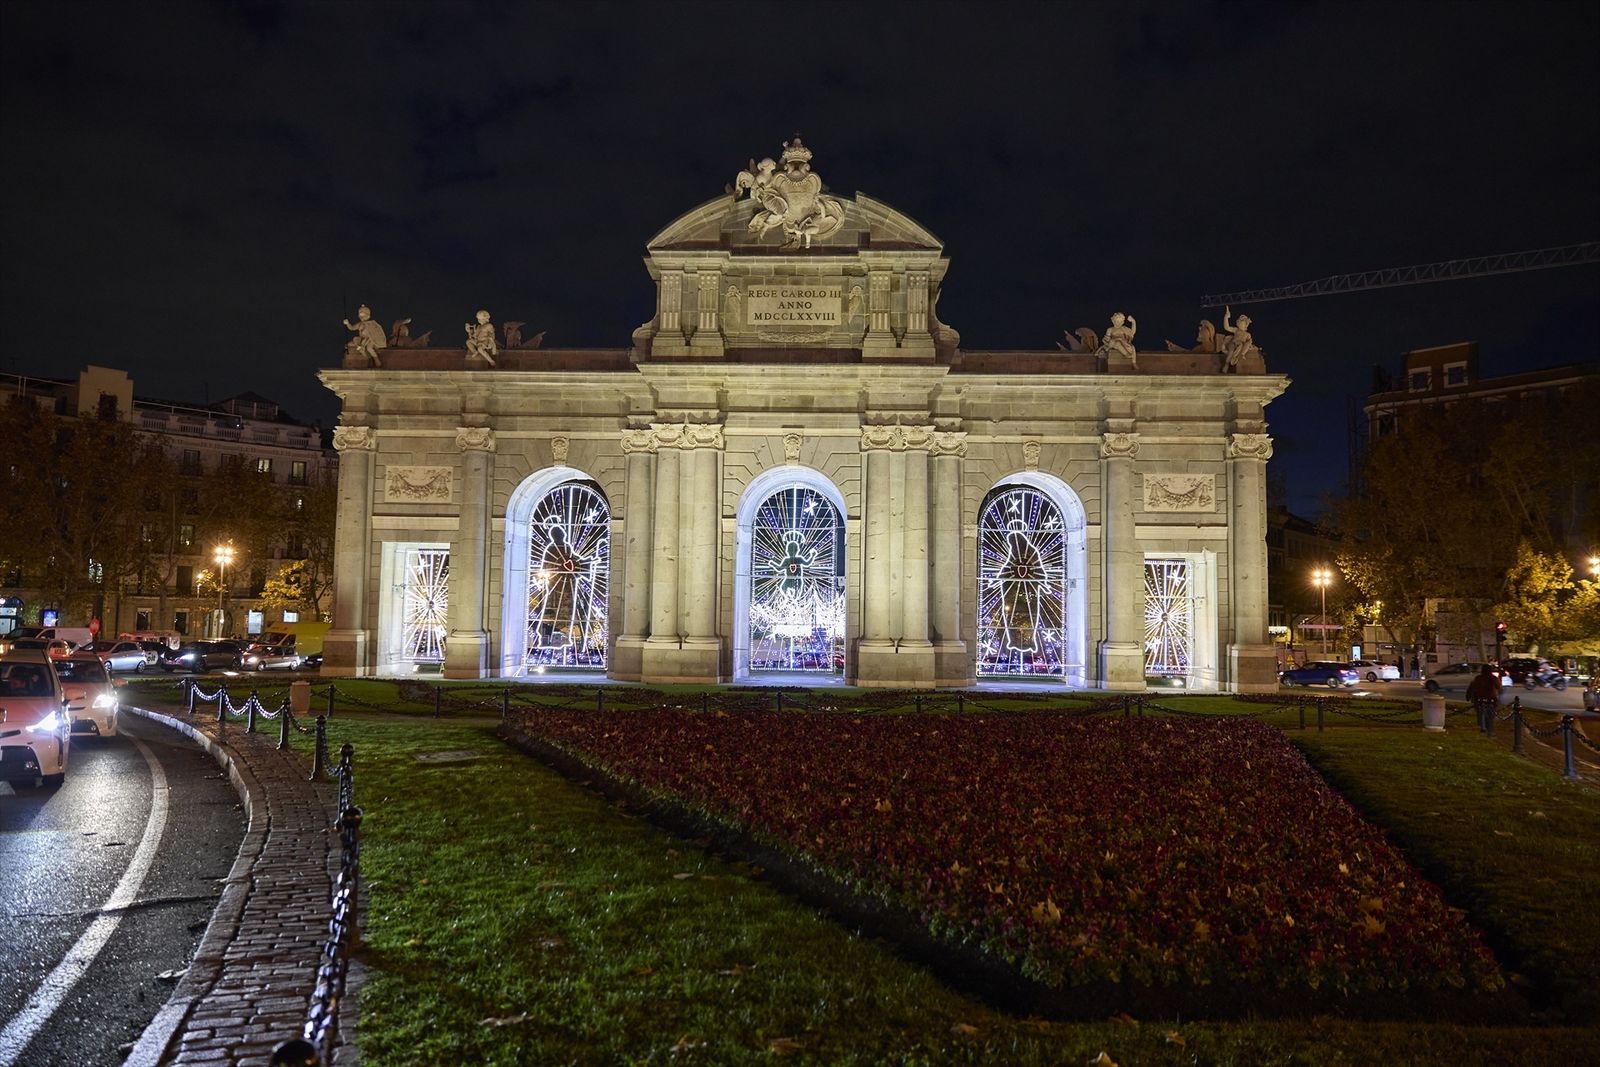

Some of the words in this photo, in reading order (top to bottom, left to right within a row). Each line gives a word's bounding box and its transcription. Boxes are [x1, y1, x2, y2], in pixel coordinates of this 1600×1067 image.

[749, 290, 777, 298] REGE
[781, 290, 826, 298] CAROLO
[830, 290, 841, 298] III
[778, 301, 812, 309] ANNO
[754, 312, 835, 320] MDCCLXXVIII
